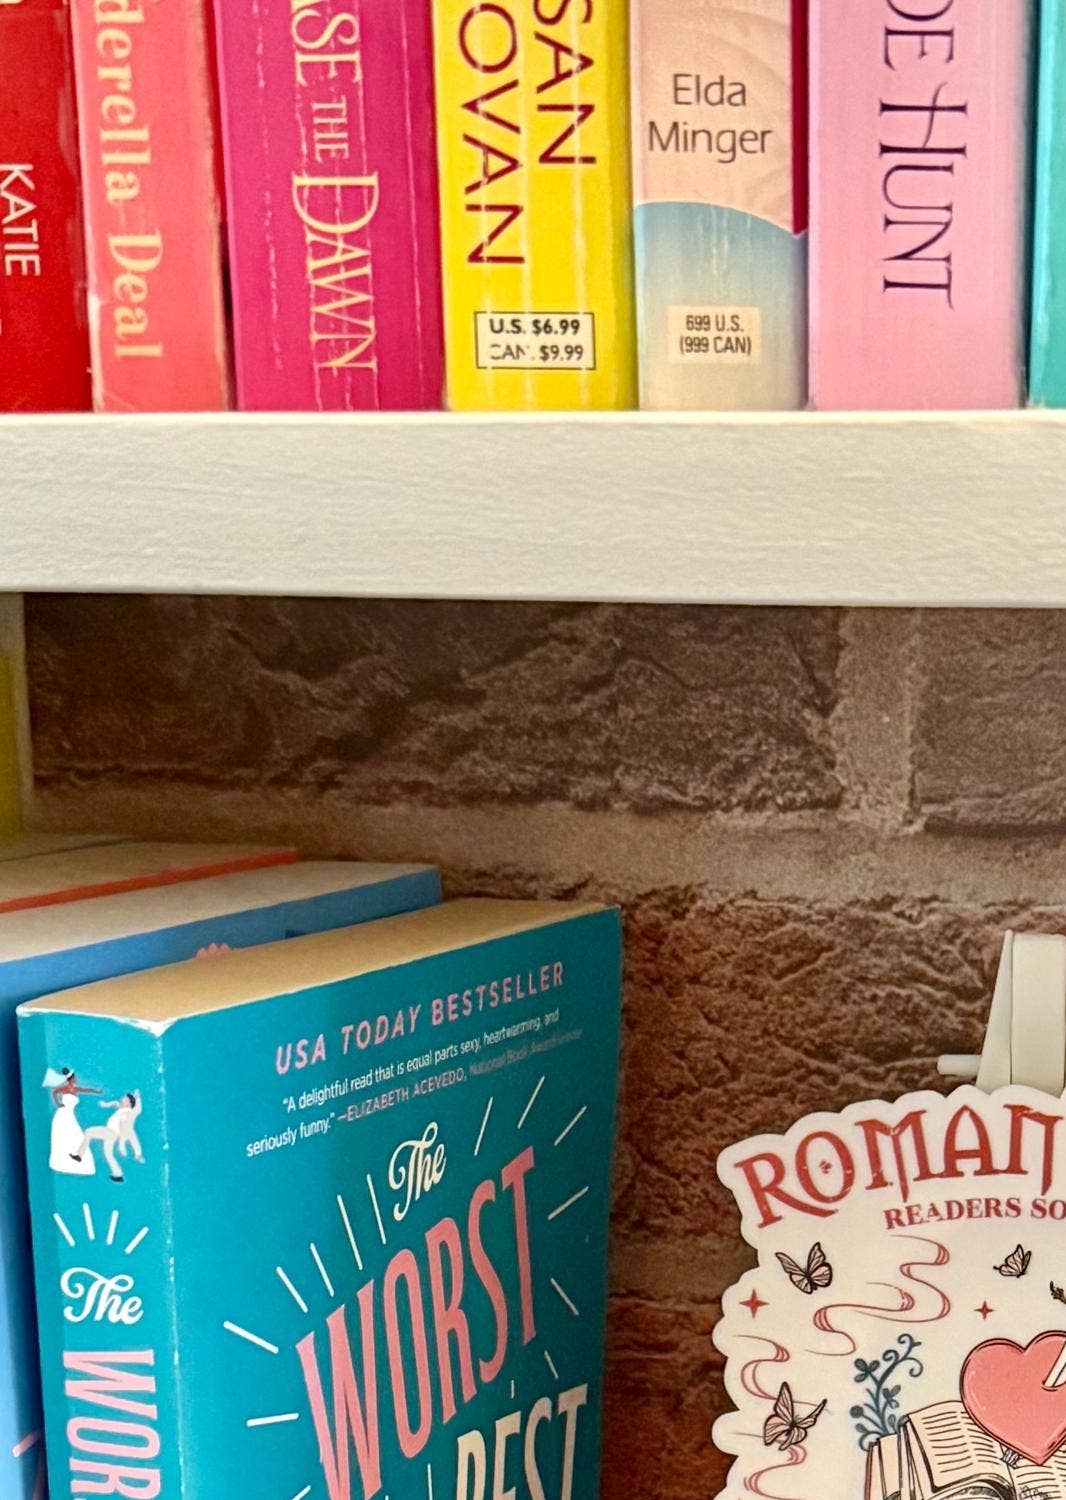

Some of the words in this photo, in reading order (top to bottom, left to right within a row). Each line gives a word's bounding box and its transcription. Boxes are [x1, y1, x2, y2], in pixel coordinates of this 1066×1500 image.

[290, 0, 363, 84] SE
[310, 96, 350, 163] THE
[672, 73, 747, 106] Elda
[458, 3, 526, 264] OVAN
[647, 121, 773, 164] Minger
[0, 163, 41, 277] KATIE
[878, 80, 969, 311] HUNT
[107, 230, 165, 359] Deal
[291, 171, 380, 370] DAWN
[489, 318, 527, 335] U.S.
[532, 318, 581, 337] $6.99
[539, 344, 585, 362] $9.99
[679, 335, 710, 354] (999
[712, 336, 752, 356] CAN)
[685, 314, 712, 332] 699
[714, 314, 745, 332] U.S.
[275, 1033, 326, 1076] USA
[341, 1003, 422, 1055] TODAY
[431, 960, 565, 1027] BESTSELLER
[298, 1077, 349, 1110] delightful
[350, 1069, 373, 1091] read
[374, 1064, 395, 1084] that
[396, 1061, 405, 1076] is
[406, 1050, 432, 1074] equal
[434, 1042, 459, 1066] parts
[460, 1036, 481, 1056] sexy,
[543, 1007, 560, 1026] and
[246, 1125, 298, 1158] seriously
[299, 1111, 336, 1140] funny."
[411, 1066, 468, 1097] ACEVEDO,
[387, 1120, 448, 1221] The
[883, 1197, 1022, 1230] READERS
[60, 1265, 145, 1326] The
